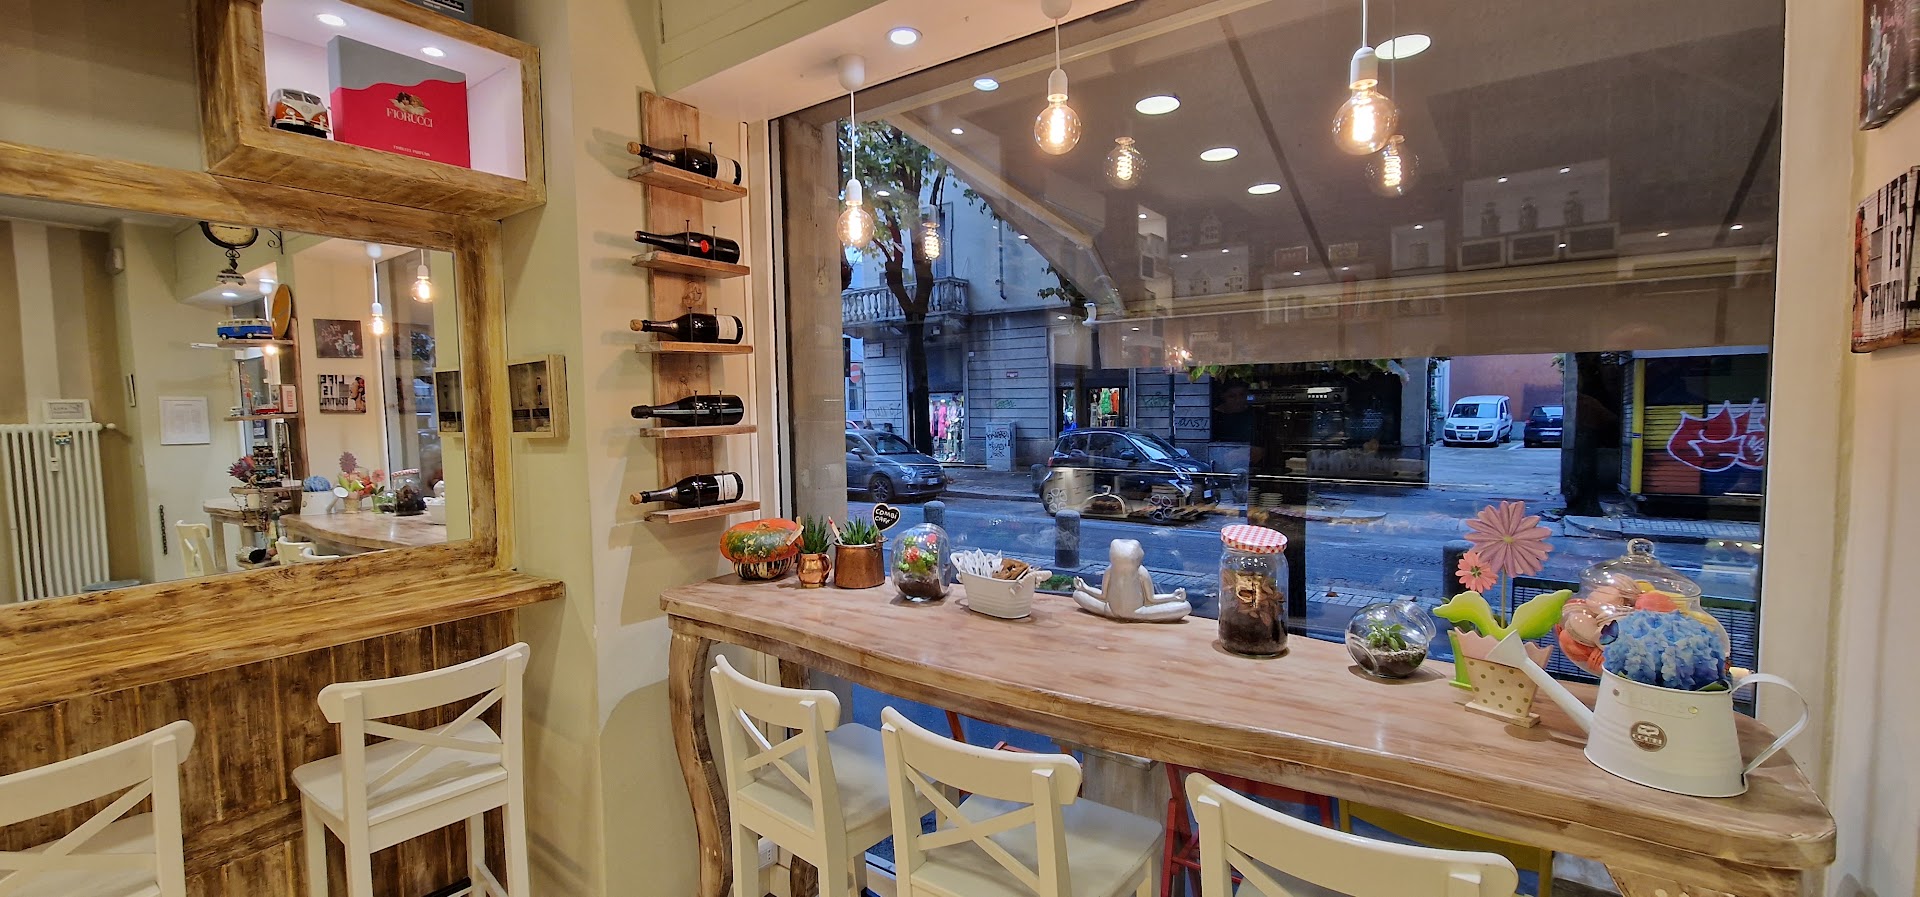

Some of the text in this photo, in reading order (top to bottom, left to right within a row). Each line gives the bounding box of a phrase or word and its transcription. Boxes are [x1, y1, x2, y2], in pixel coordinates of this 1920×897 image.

[386, 108, 433, 128] FIORUCCI
[1877, 172, 1907, 227] LIFE
[1889, 226, 1902, 271] IS
